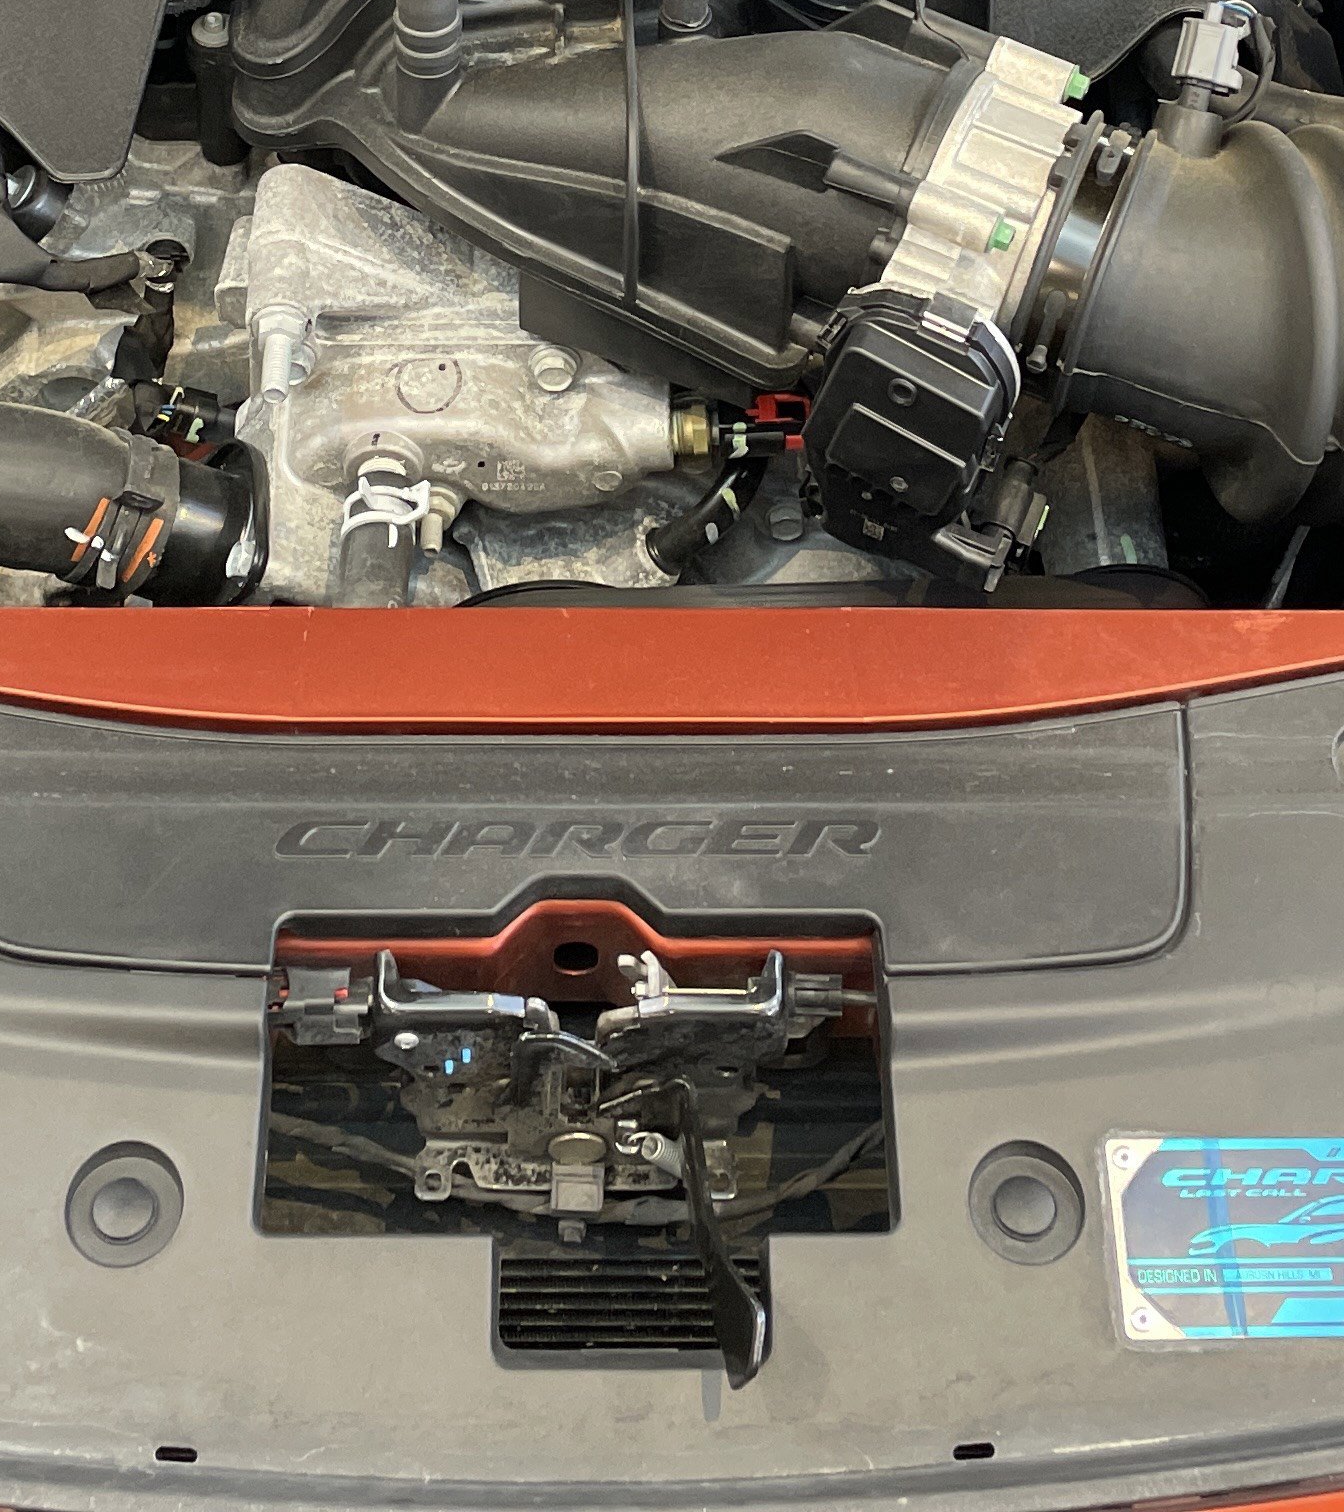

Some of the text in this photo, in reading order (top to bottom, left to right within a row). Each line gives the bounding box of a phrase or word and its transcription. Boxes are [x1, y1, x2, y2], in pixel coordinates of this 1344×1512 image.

[274, 819, 882, 859] CHARGER
[1179, 1188, 1307, 1198] LAST CALL
[1137, 1268, 1200, 1284] DESIGNED
[1203, 1268, 1217, 1283] IN
